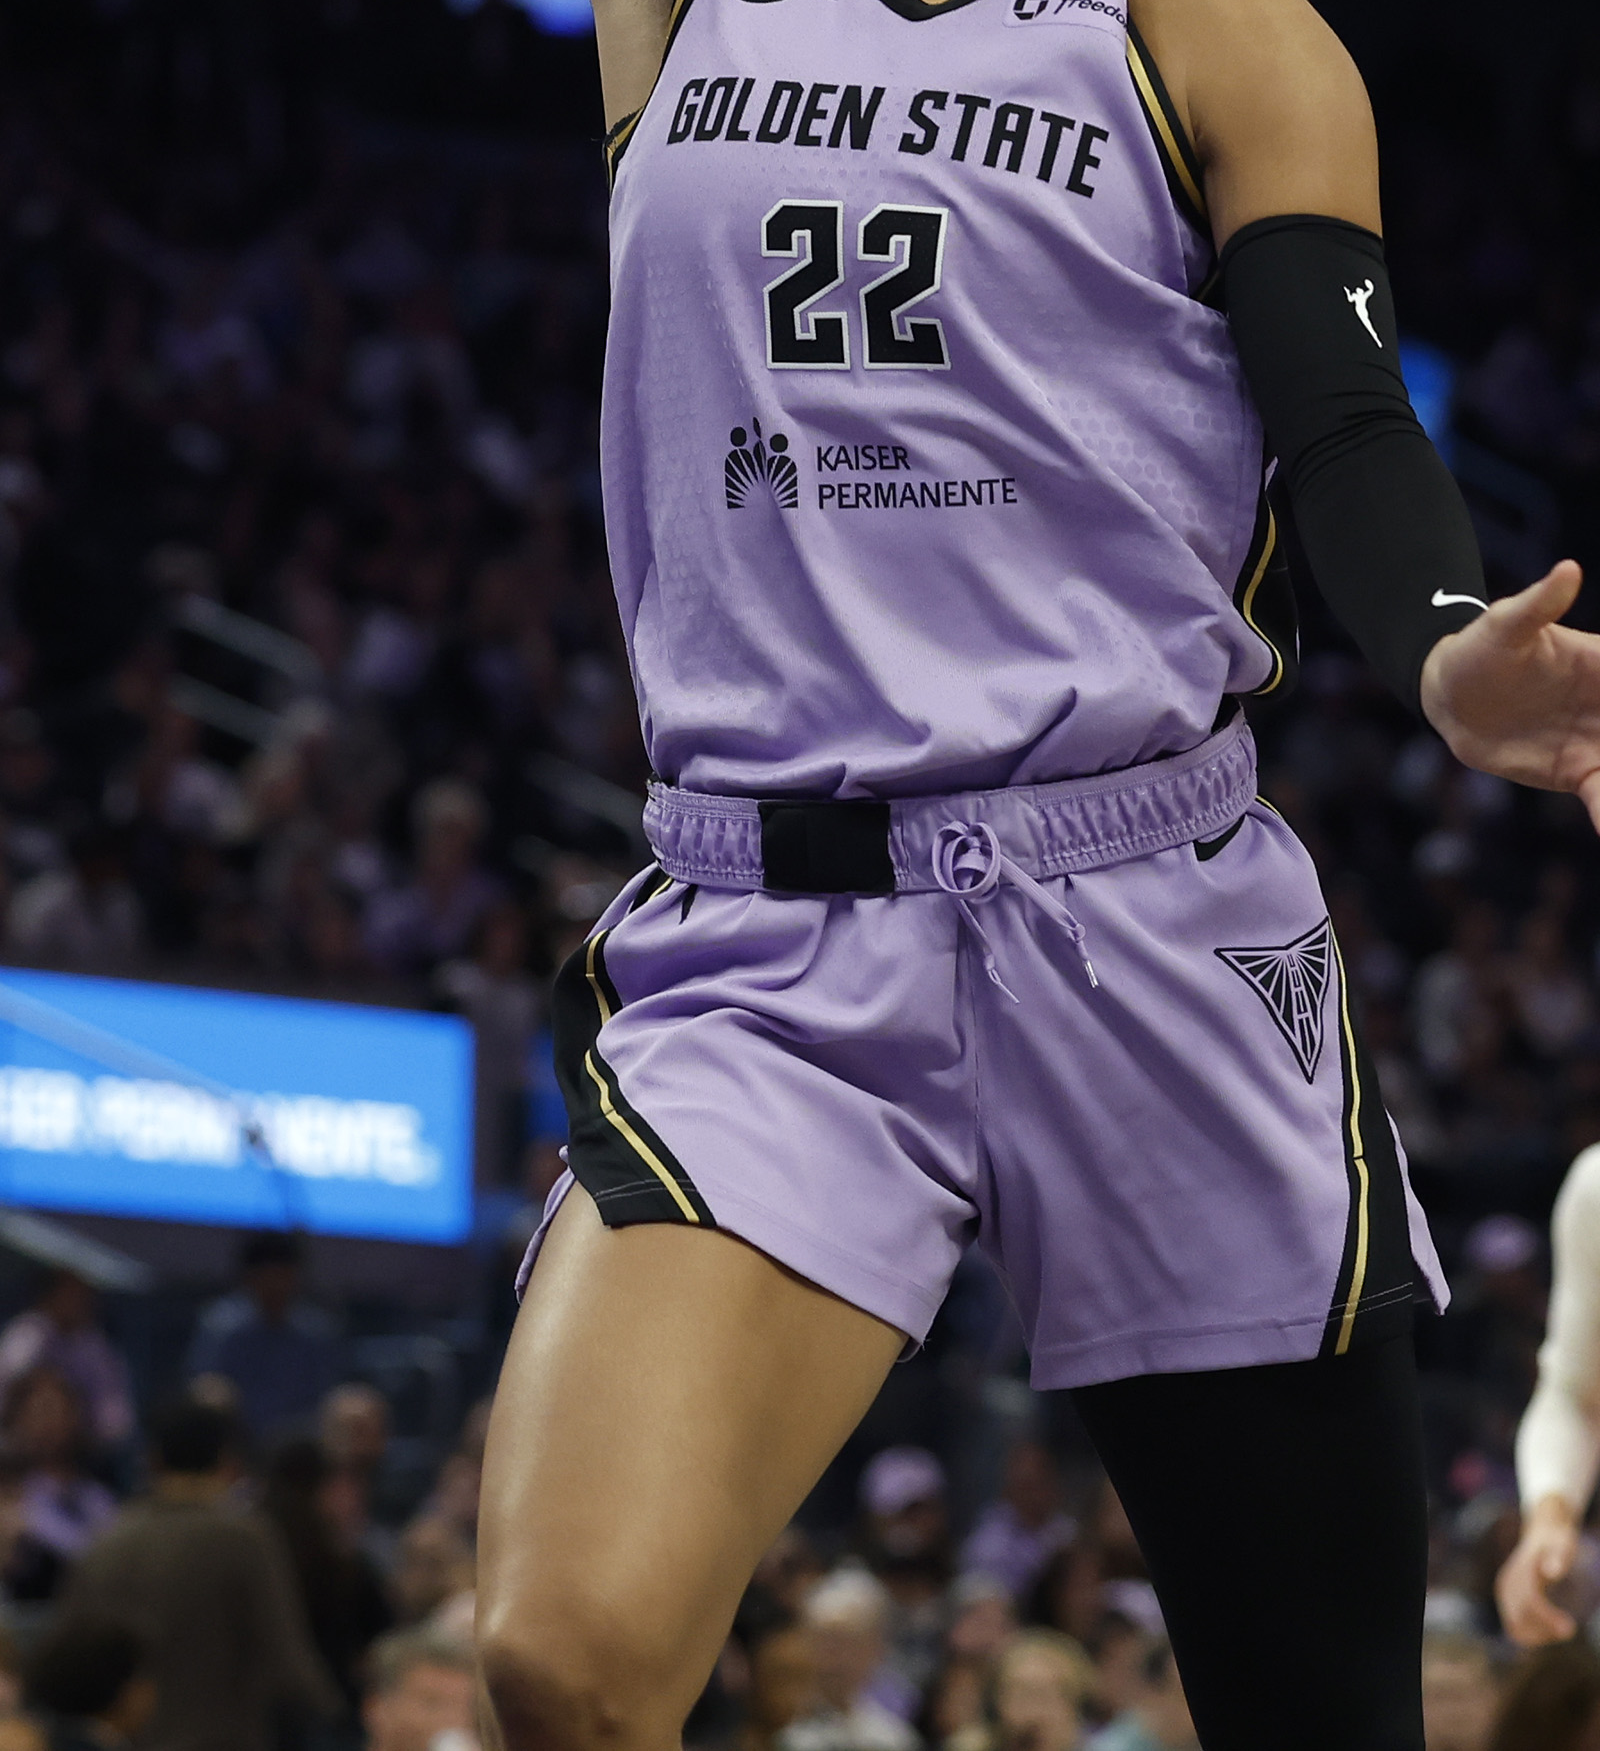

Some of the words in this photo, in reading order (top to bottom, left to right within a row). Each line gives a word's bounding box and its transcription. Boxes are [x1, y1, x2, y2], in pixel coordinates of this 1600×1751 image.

[667, 77, 885, 150] GOLDEN
[900, 89, 1109, 198] STATE
[761, 198, 951, 371] 22
[816, 445, 910, 472] KAISER
[818, 478, 1017, 509] PERMANENTE
